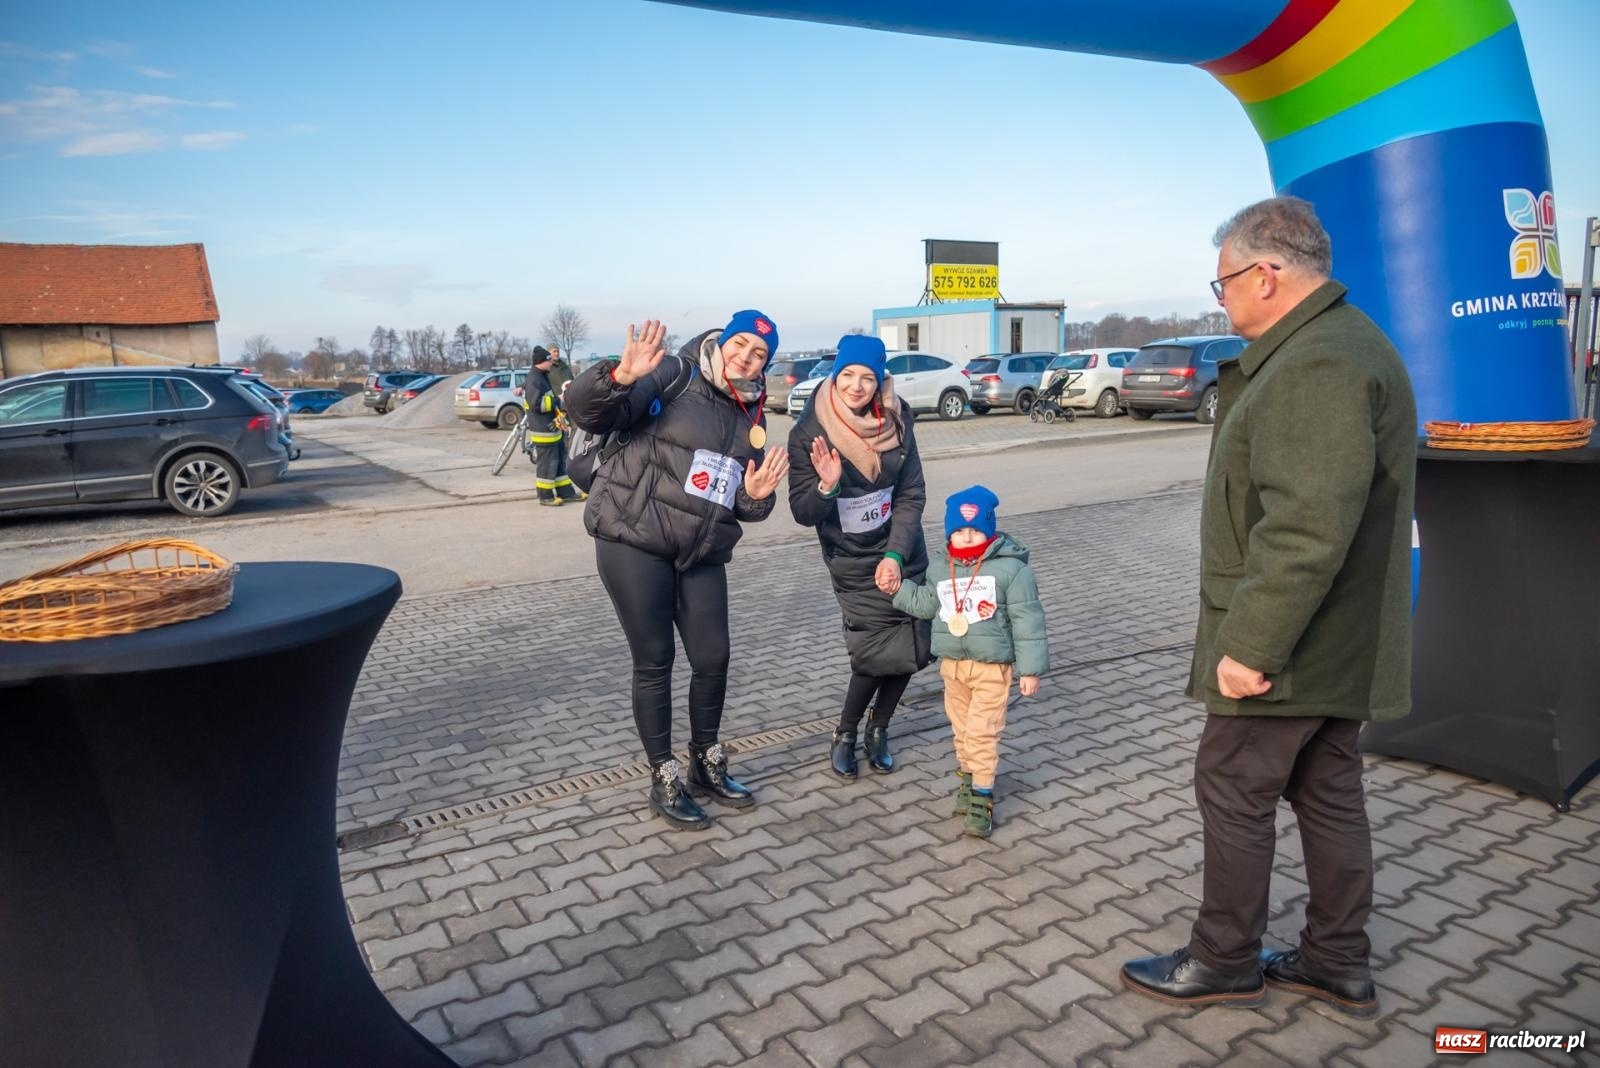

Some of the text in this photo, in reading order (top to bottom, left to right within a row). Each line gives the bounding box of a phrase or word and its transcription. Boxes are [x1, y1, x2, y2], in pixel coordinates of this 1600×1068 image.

[934, 276, 997, 288] 575 792 626
[1451, 294, 1518, 318] GMINA
[1498, 319, 1527, 330] odkryj
[1532, 318, 1554, 328] poznaj
[710, 477, 729, 495] 43
[861, 508, 879, 522] 46
